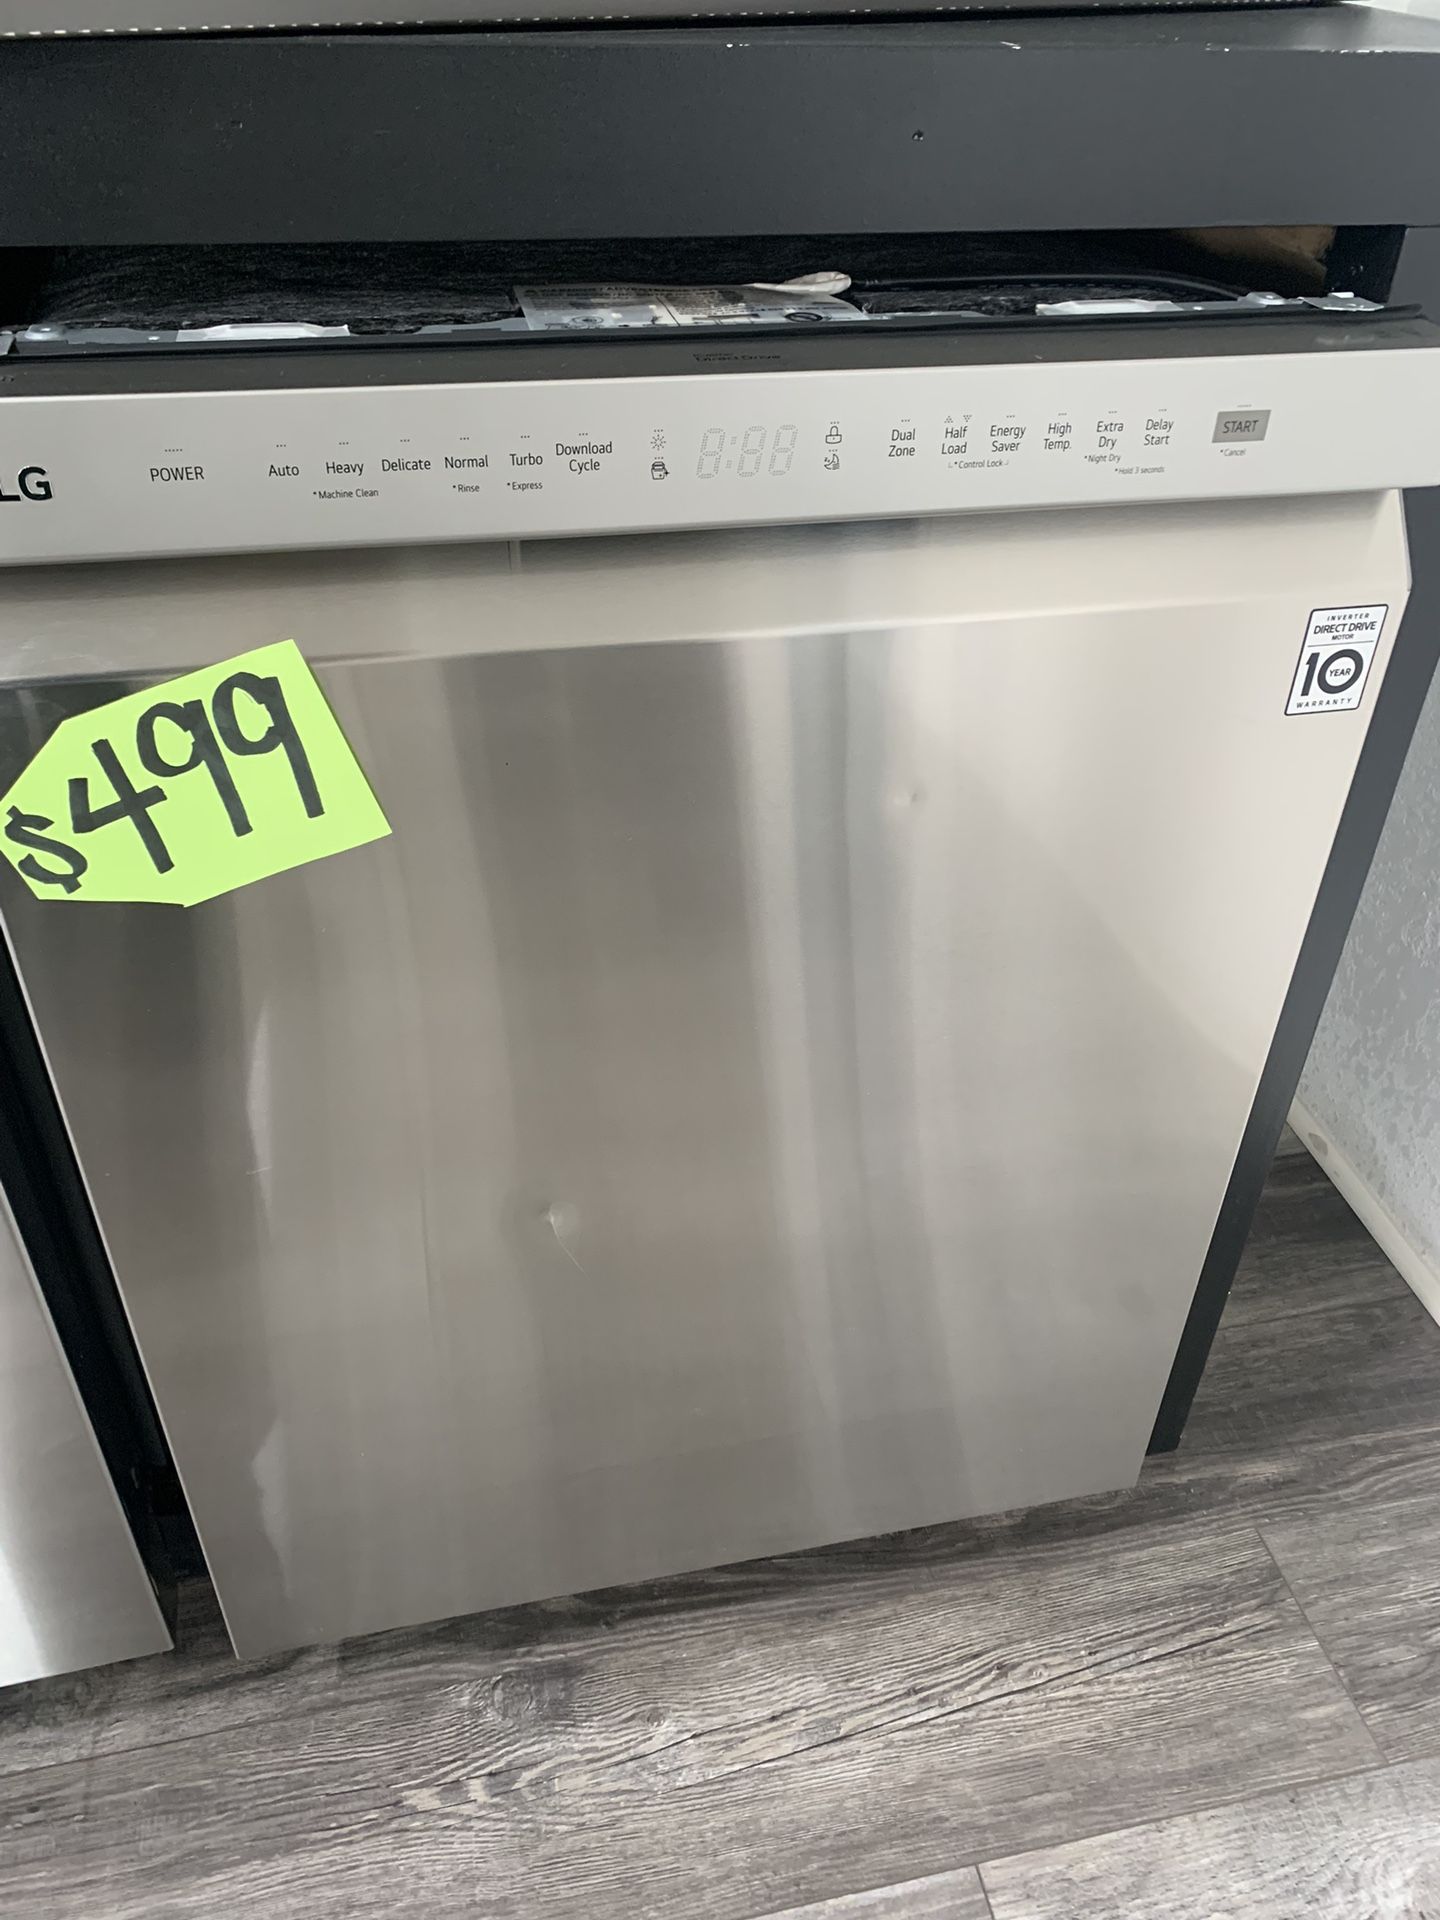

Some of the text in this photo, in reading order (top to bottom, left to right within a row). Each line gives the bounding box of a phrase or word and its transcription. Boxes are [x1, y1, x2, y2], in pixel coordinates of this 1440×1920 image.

[944, 425, 968, 439] Half
[989, 424, 1027, 440] Energy
[1047, 421, 1072, 437] High
[1096, 419, 1124, 433] Extra
[1145, 417, 1174, 433] Delay
[1222, 419, 1260, 434] START
[891, 428, 916, 442] Dual
[1143, 432, 1170, 446] Start
[555, 441, 613, 458] Download
[941, 442, 968, 455] Load
[991, 439, 1021, 453] Saver
[1043, 437, 1072, 452] Temp.
[1098, 435, 1118, 450] Dry
[888, 444, 916, 458] Zone
[1108, 453, 1121, 463] Dry
[381, 458, 432, 473] Delicate
[444, 455, 489, 470] Normal
[509, 453, 544, 467] Turbo
[568, 458, 601, 475] Cycle
[986, 459, 1003, 468] Lock
[150, 466, 205, 482] POWER
[268, 464, 300, 477] Auto
[325, 461, 364, 477] Heavy
[1140, 466, 1165, 474] seconds
[355, 488, 379, 498] Clean
[1327, 612, 1370, 622] INVERTER
[1313, 621, 1377, 635] DIRECT DRIVE
[1331, 633, 1354, 641] MOTOR
[1300, 648, 1364, 697] 10
[1329, 667, 1352, 677] YEAR
[1296, 697, 1353, 709] WARRANTY
[4, 671, 325, 894] $499
